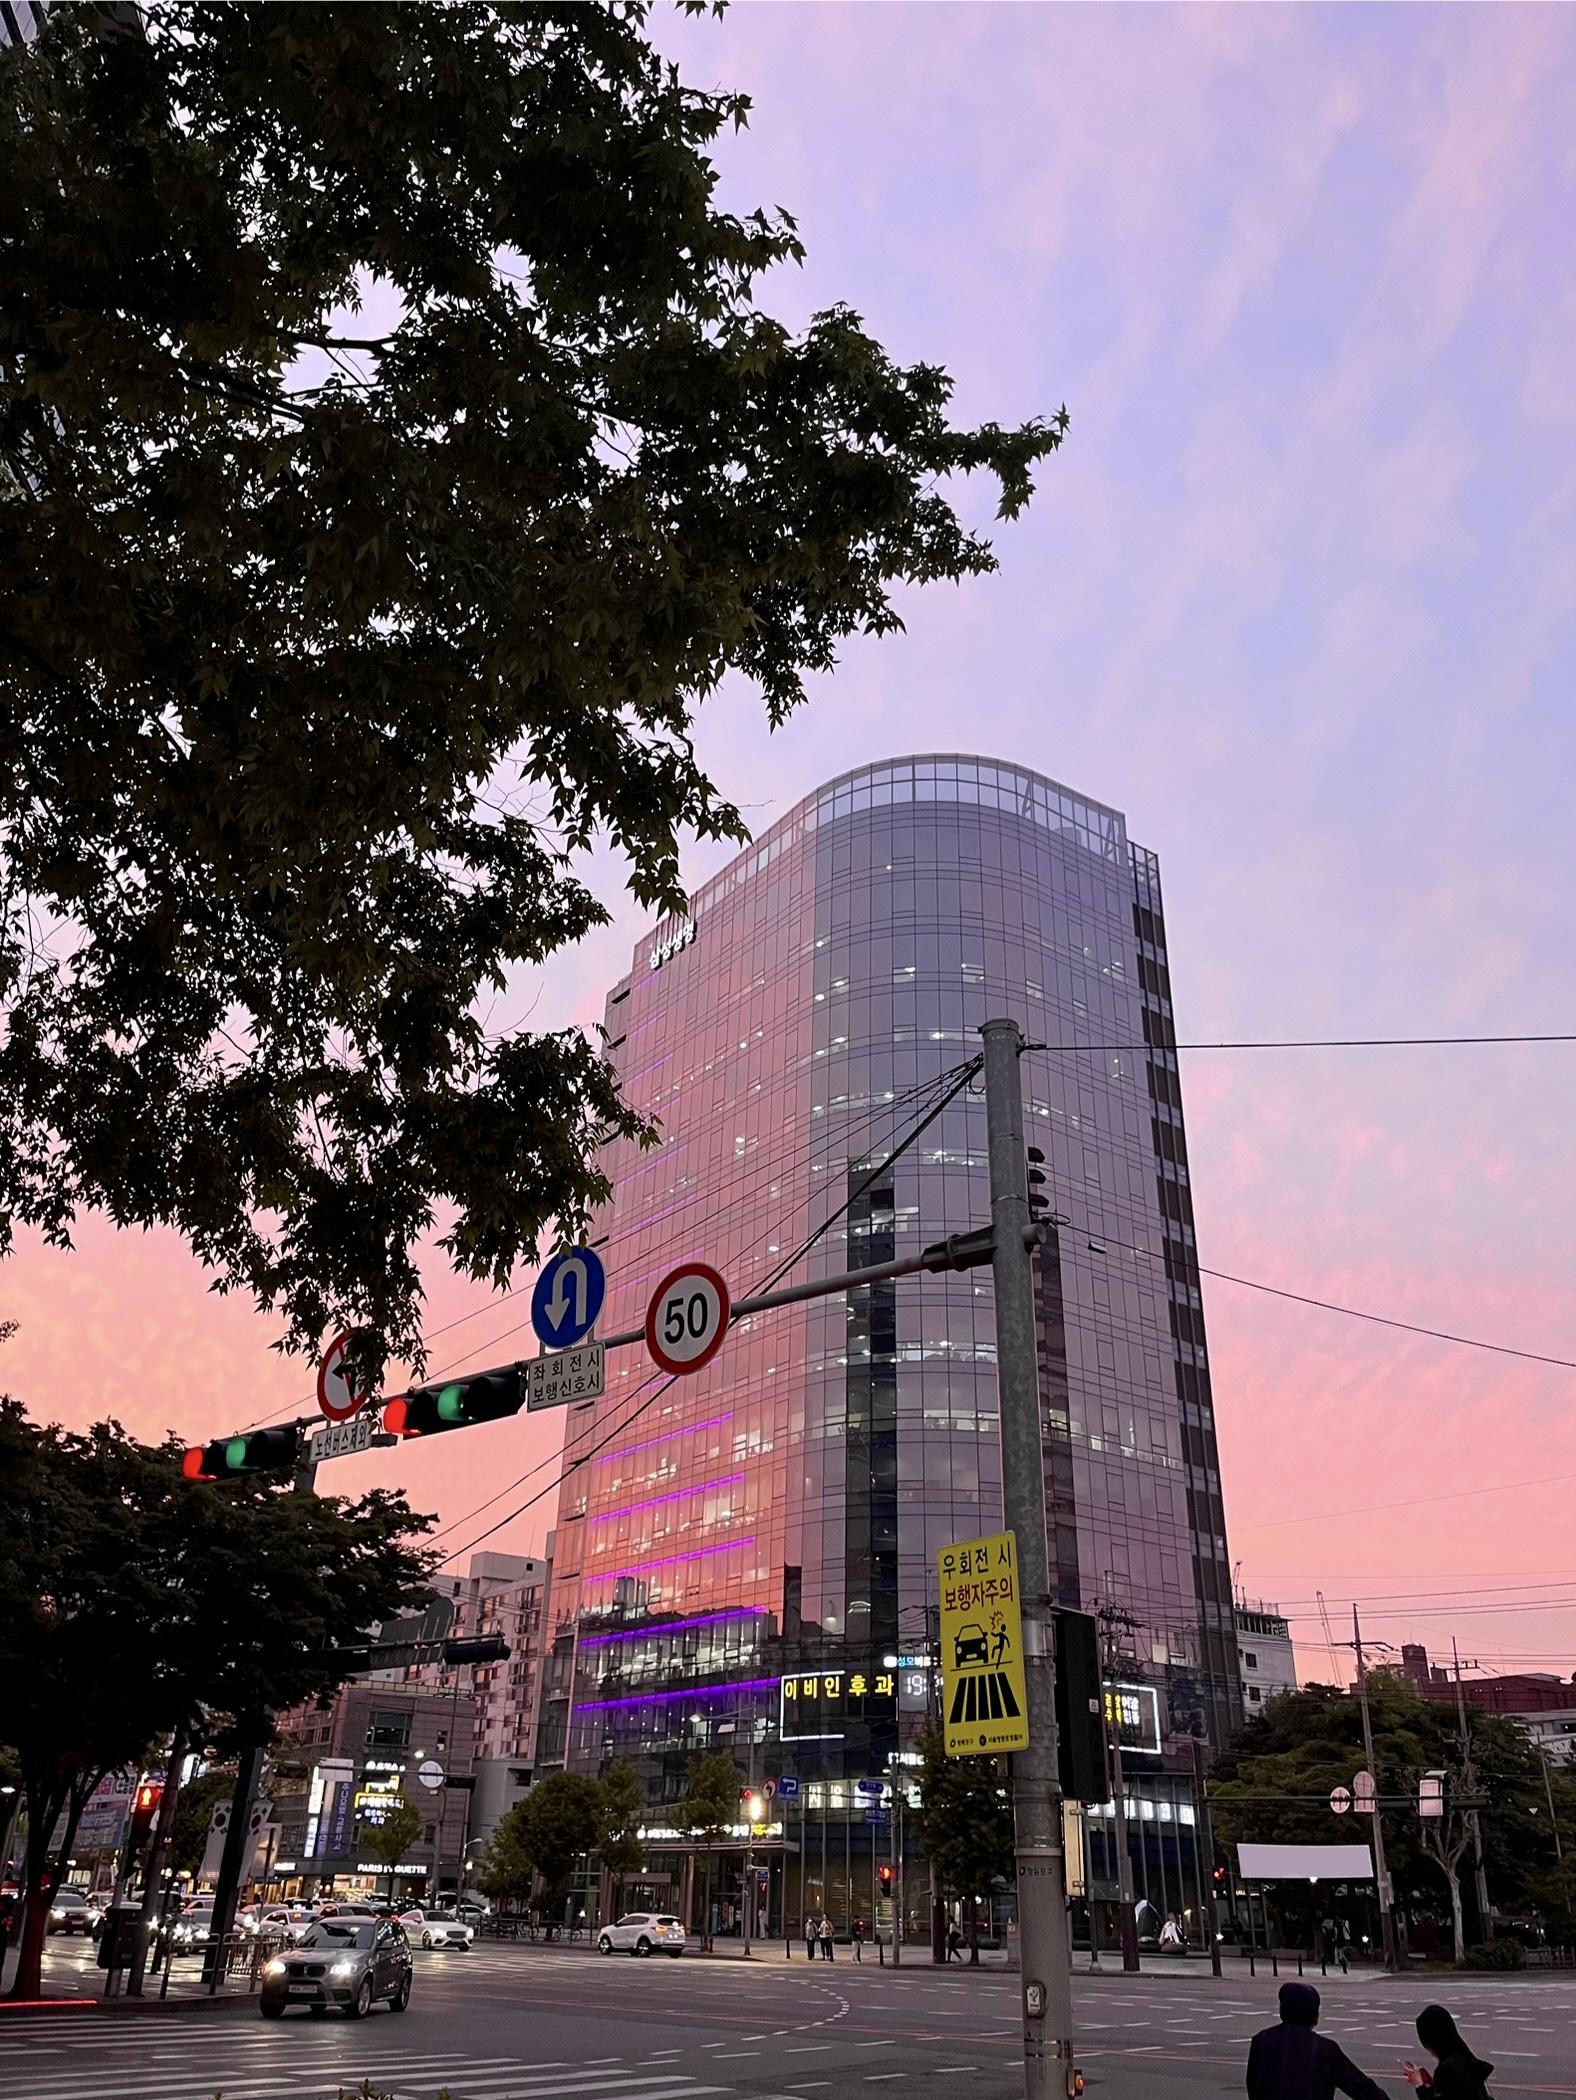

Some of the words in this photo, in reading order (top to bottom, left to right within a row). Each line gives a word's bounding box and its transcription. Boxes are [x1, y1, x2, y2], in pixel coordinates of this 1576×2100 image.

[664, 1292, 708, 1344] 50
[532, 1371, 600, 1404] 보행신호시
[315, 1421, 368, 1457] 노선버스제외
[943, 1546, 989, 1580] 우회전
[998, 1541, 1011, 1568] 시
[944, 1575, 1013, 1612] 보행자주의
[784, 1673, 895, 1701] 이비인후과
[357, 1863, 383, 1873] PARIS
